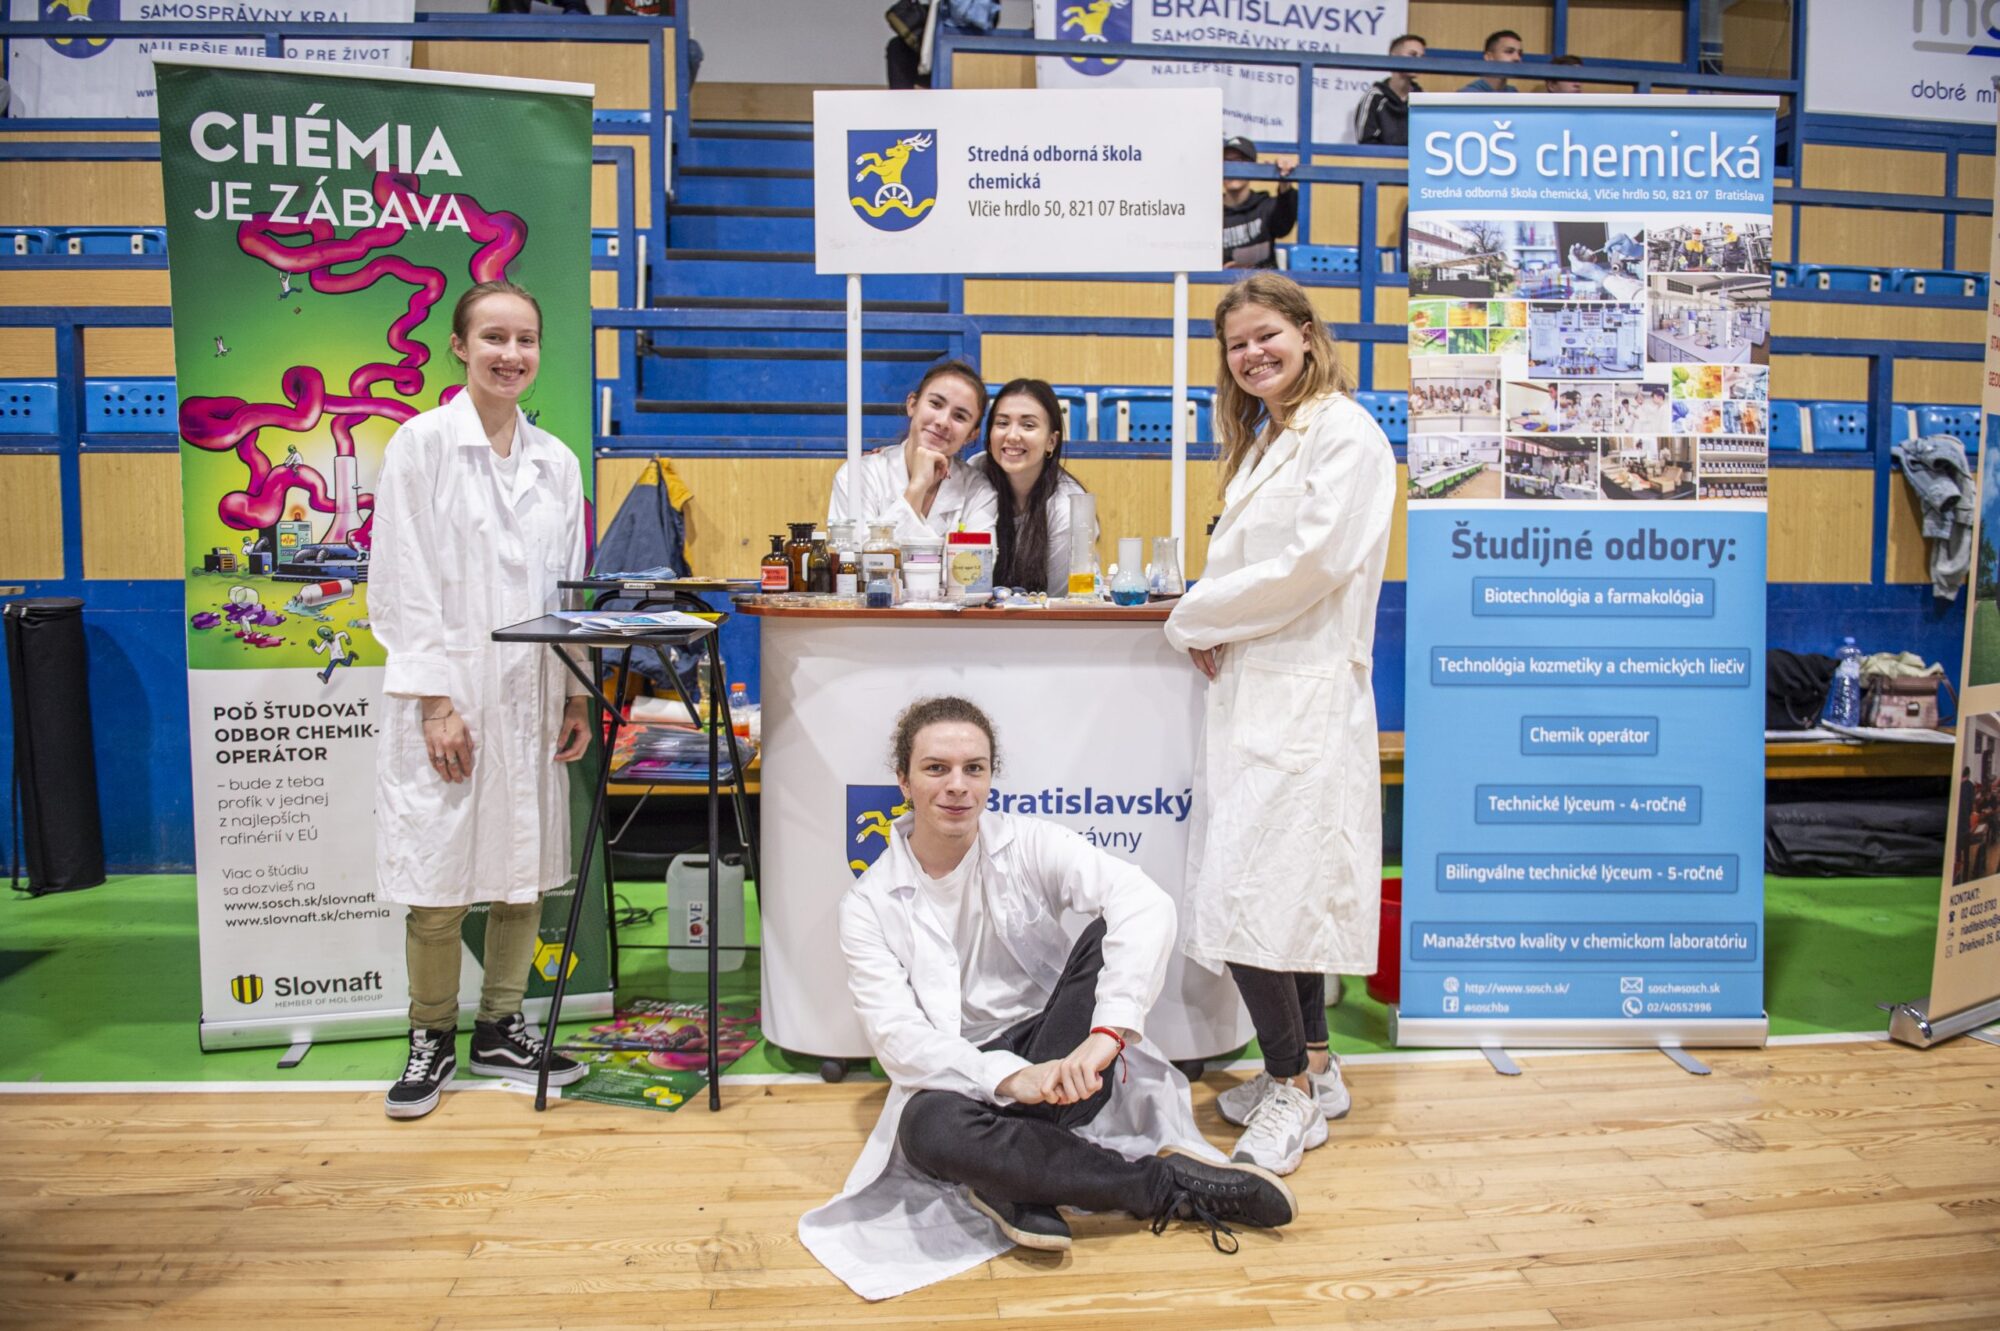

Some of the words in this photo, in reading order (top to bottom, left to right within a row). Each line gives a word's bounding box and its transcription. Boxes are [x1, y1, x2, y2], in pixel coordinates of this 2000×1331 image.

[139, 3, 293, 22] SAMOSPRÁVNY
[1151, 0, 1387, 36] BRATISLAVSKÝ
[1151, 27, 1291, 50] SAMOSPRÁVNY
[235, 46, 298, 59] MIEO
[305, 50, 337, 60] PRE
[342, 47, 390, 60] ŽIVOT
[1239, 69, 1296, 86] MIESTO
[1312, 77, 1330, 89] RE
[1334, 76, 1372, 92] ŽIVO
[1911, 80, 1967, 101] dobré
[190, 103, 463, 177] CHÉMIA
[1424, 120, 1517, 177] SOŠ
[1536, 129, 1761, 179] chemická
[968, 145, 1029, 162] Stredná
[1033, 145, 1098, 162] odborná
[1102, 145, 1142, 162] škola
[968, 172, 1041, 189] chemická
[193, 181, 254, 222] JE
[268, 176, 471, 233] ZÁBAVA
[1420, 187, 1463, 200] Stredná
[1465, 187, 1507, 200] odborná
[1510, 187, 1538, 200] škola
[1540, 187, 1591, 201] chemická,
[1594, 188, 1620, 201] Vlčie
[1622, 188, 1650, 201] hrdlo
[1652, 190, 1669, 203] 50,
[1672, 190, 1692, 201] 821
[1695, 190, 1709, 201] 07
[1715, 189, 1765, 202] Bratislava
[968, 200, 1000, 217] Vlčie
[1004, 200, 1040, 217] hrdlo
[1044, 200, 1065, 218] 50,
[1068, 200, 1094, 217] 821
[1098, 200, 1115, 217] 07
[1119, 200, 1186, 217] Bratislava
[1452, 521, 1592, 567] Študijné
[1605, 529, 1736, 568] odbory:
[1484, 588, 1589, 606] Biotechnológia
[1594, 591, 1603, 604] a
[1608, 588, 1704, 607] farmakológia
[1439, 657, 1525, 676] Technológia
[1530, 657, 1602, 676] kozmetiky
[1606, 661, 1615, 673] a
[1619, 658, 1704, 677] chemických
[1710, 658, 1744, 675] liečiv
[213, 701, 258, 720] POĎ
[263, 698, 370, 719] ŠTUDOVAŤ
[215, 727, 290, 742] ODBOR
[296, 724, 380, 740] CHEMIK-
[1530, 727, 1584, 742] Chemik
[1588, 728, 1650, 745] operátor
[216, 744, 328, 764] OPERÁTOR
[229, 777, 271, 791] bude
[275, 778, 284, 789] z
[287, 776, 325, 788] teba
[218, 794, 263, 811] profík
[266, 797, 275, 807] v
[279, 792, 329, 809] jednej
[985, 787, 1193, 822] Bratislavský
[1488, 795, 1559, 812] Technické
[1563, 796, 1615, 815] lýceum
[1630, 796, 1687, 812] 4-ročné
[219, 817, 228, 828] z
[231, 811, 311, 828] najlepších
[220, 829, 282, 845] rafinérií
[285, 831, 294, 841] v
[298, 825, 318, 841] EÚ
[222, 867, 252, 879] Viac
[255, 868, 265, 878] o
[267, 864, 309, 877] štúdiu
[1446, 864, 1525, 882] Bilingválne
[1529, 864, 1597, 880] technické
[1602, 865, 1652, 883] lýceum
[1668, 865, 1723, 880] 5-ročné
[223, 885, 239, 896] sa
[242, 880, 293, 895] dozvieš
[296, 881, 315, 892] na
[224, 892, 376, 911] www.sosch.sk/slovnaft
[225, 908, 391, 927] www.slovnaft.sk/chemia
[1423, 932, 1515, 949] Manažérstvo
[1519, 933, 1566, 952] kvality
[1571, 937, 1579, 949] v
[1583, 933, 1665, 949] chemickom
[1669, 933, 1747, 949] laboratóriu
[274, 970, 382, 997] Slovnaft
[1465, 982, 1570, 994] http://www.sosch.sk/
[275, 999, 312, 1008] MEMBER
[315, 998, 326, 1006] OF
[328, 995, 349, 1004] MOL
[351, 993, 383, 1003] GROUP
